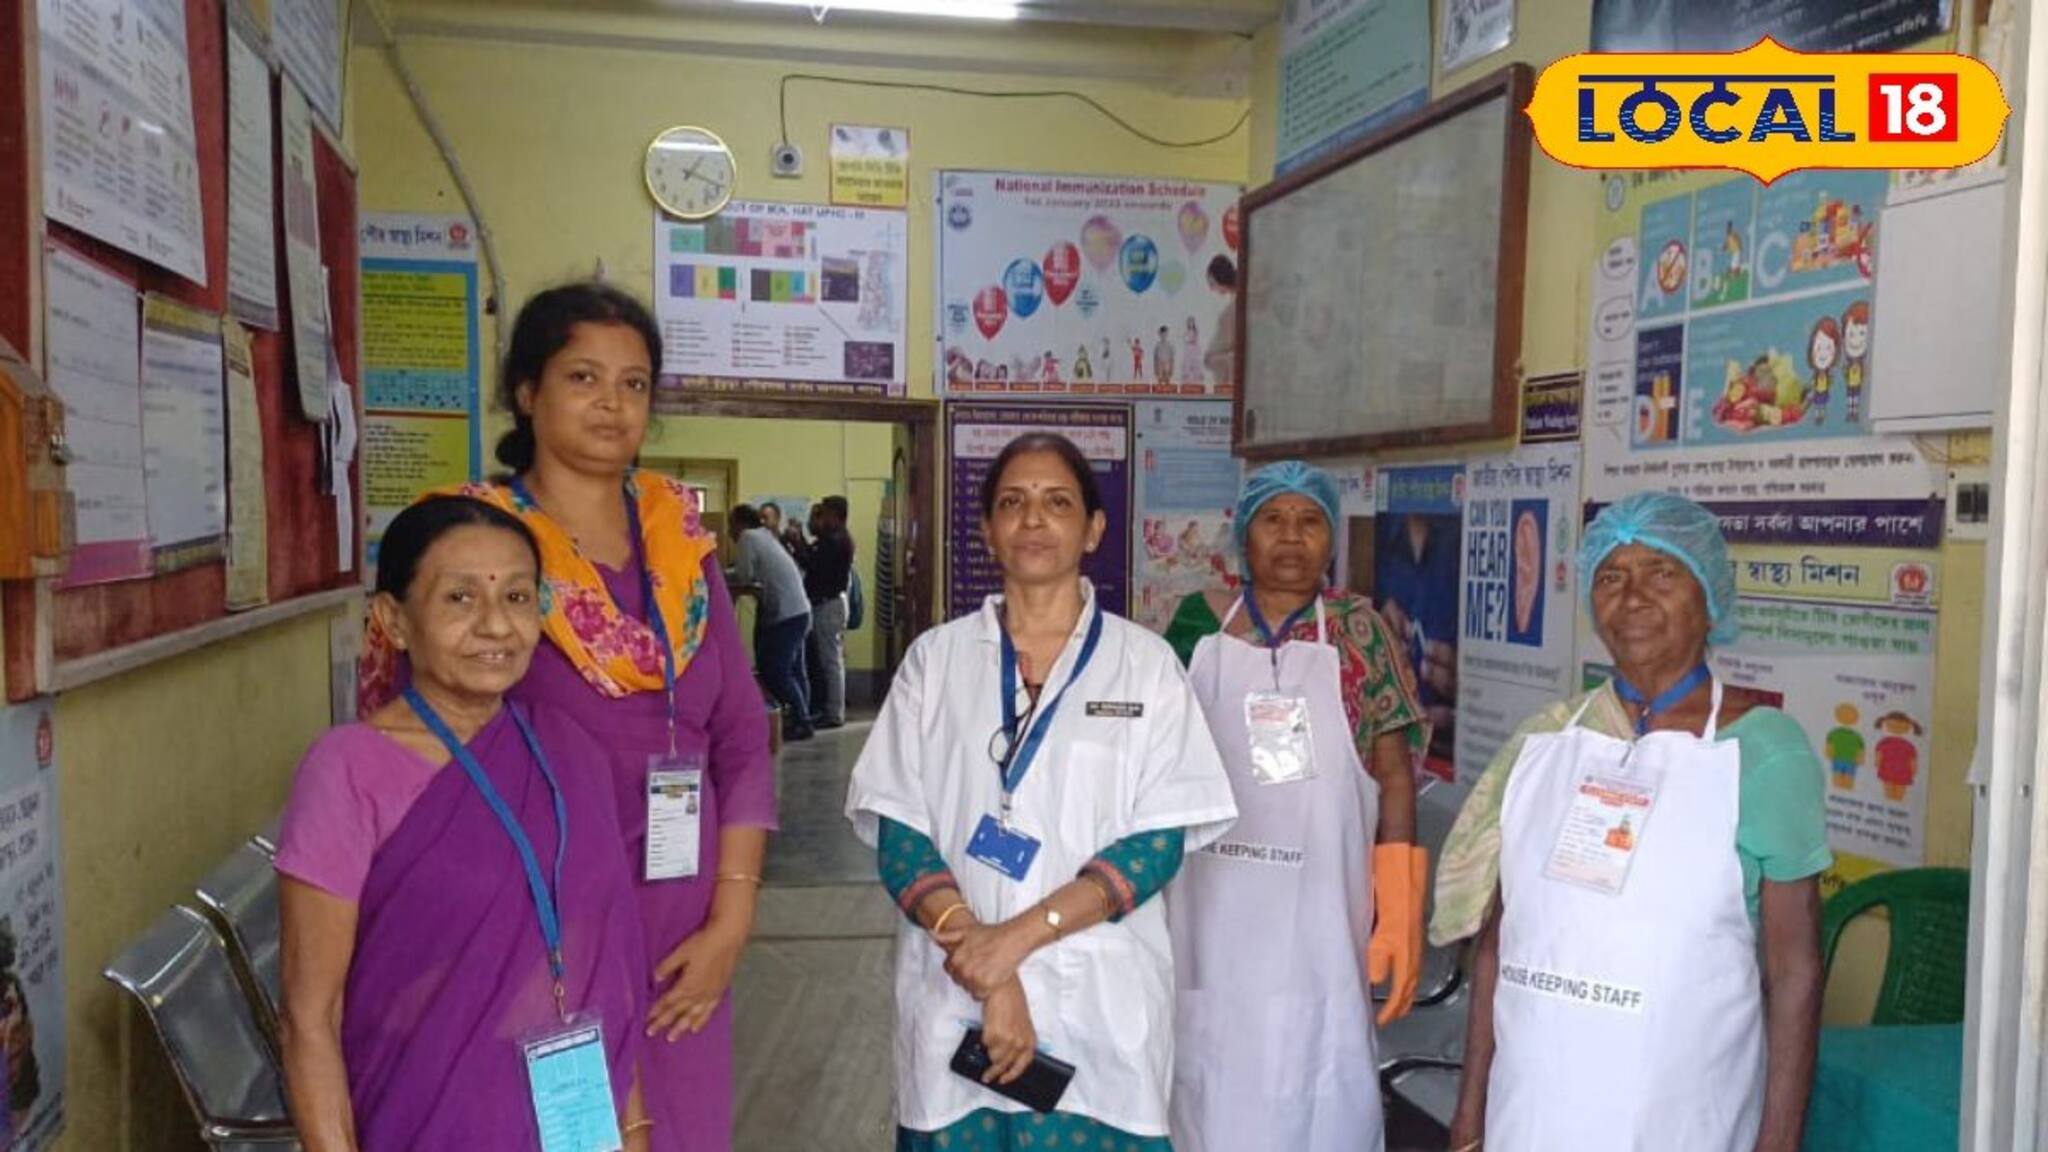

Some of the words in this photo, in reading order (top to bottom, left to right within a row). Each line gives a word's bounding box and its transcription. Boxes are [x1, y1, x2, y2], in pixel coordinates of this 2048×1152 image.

[996, 178, 1051, 193] National
[1056, 180, 1144, 195] Immunization
[1149, 182, 1205, 197] Schedule
[1799, 515, 1867, 535] আপনার
[1874, 515, 1924, 536] পাশে
[1467, 530, 1508, 579] HEAR
[1801, 555, 1860, 586] মিশন
[1464, 580, 1507, 642] ME?
[1529, 971, 1588, 1000] KEEPING
[1591, 983, 1642, 1008] STAFF
